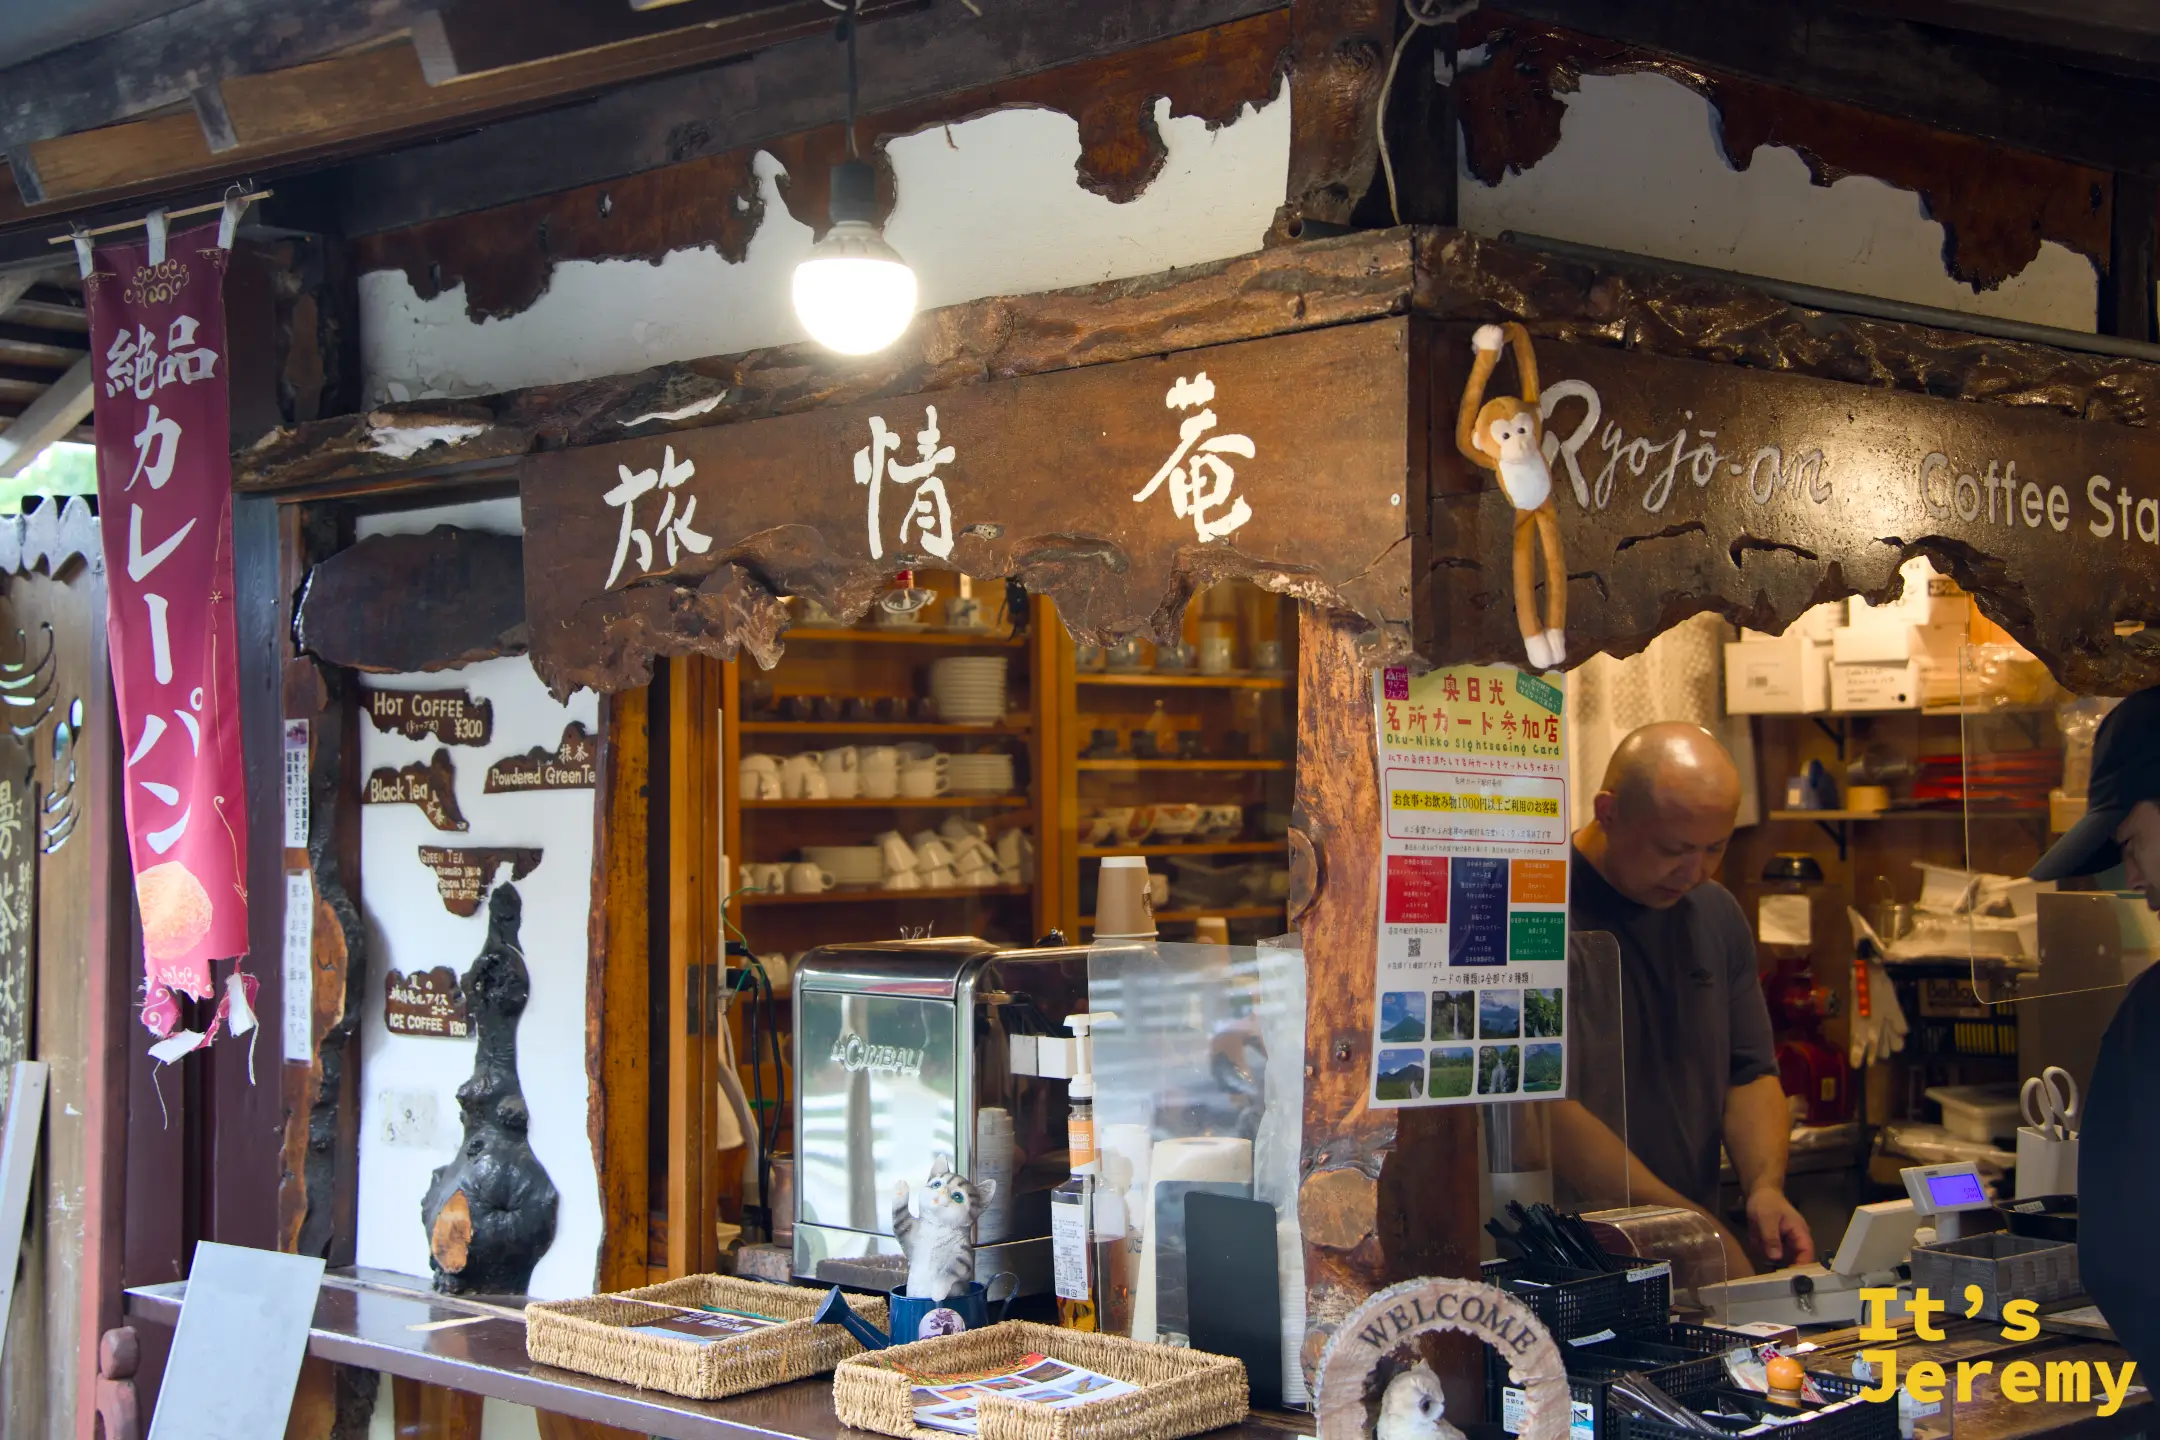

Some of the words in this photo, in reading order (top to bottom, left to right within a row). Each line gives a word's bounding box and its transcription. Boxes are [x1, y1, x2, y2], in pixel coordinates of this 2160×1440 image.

[106, 314, 219, 400] 絶品
[602, 371, 1255, 590] 旅情庵
[1920, 451, 2072, 532] Coffee
[2086, 474, 2160, 545] Sta
[124, 405, 204, 855] カレーパン
[1443, 673, 1506, 707] 奥日光
[411, 694, 464, 718] COFFEE
[454, 718, 483, 739] ¥300
[1384, 703, 1559, 743] 名所カード参加店
[558, 742, 589, 764] 抹茶
[1386, 733, 1450, 748] Oku-Nikko
[1455, 738, 1527, 757] Sightseeing
[1532, 745, 1560, 756] Card
[370, 778, 406, 803] Black
[405, 775, 428, 801] Tea
[491, 765, 542, 787] Powdered
[545, 766, 582, 785] Green
[419, 848, 444, 864] GREEN
[446, 848, 465, 864] TEA
[389, 1012, 405, 1029] ICE
[406, 1014, 444, 1032] COFFEE
[1356, 1292, 1539, 1357] WELCOME
